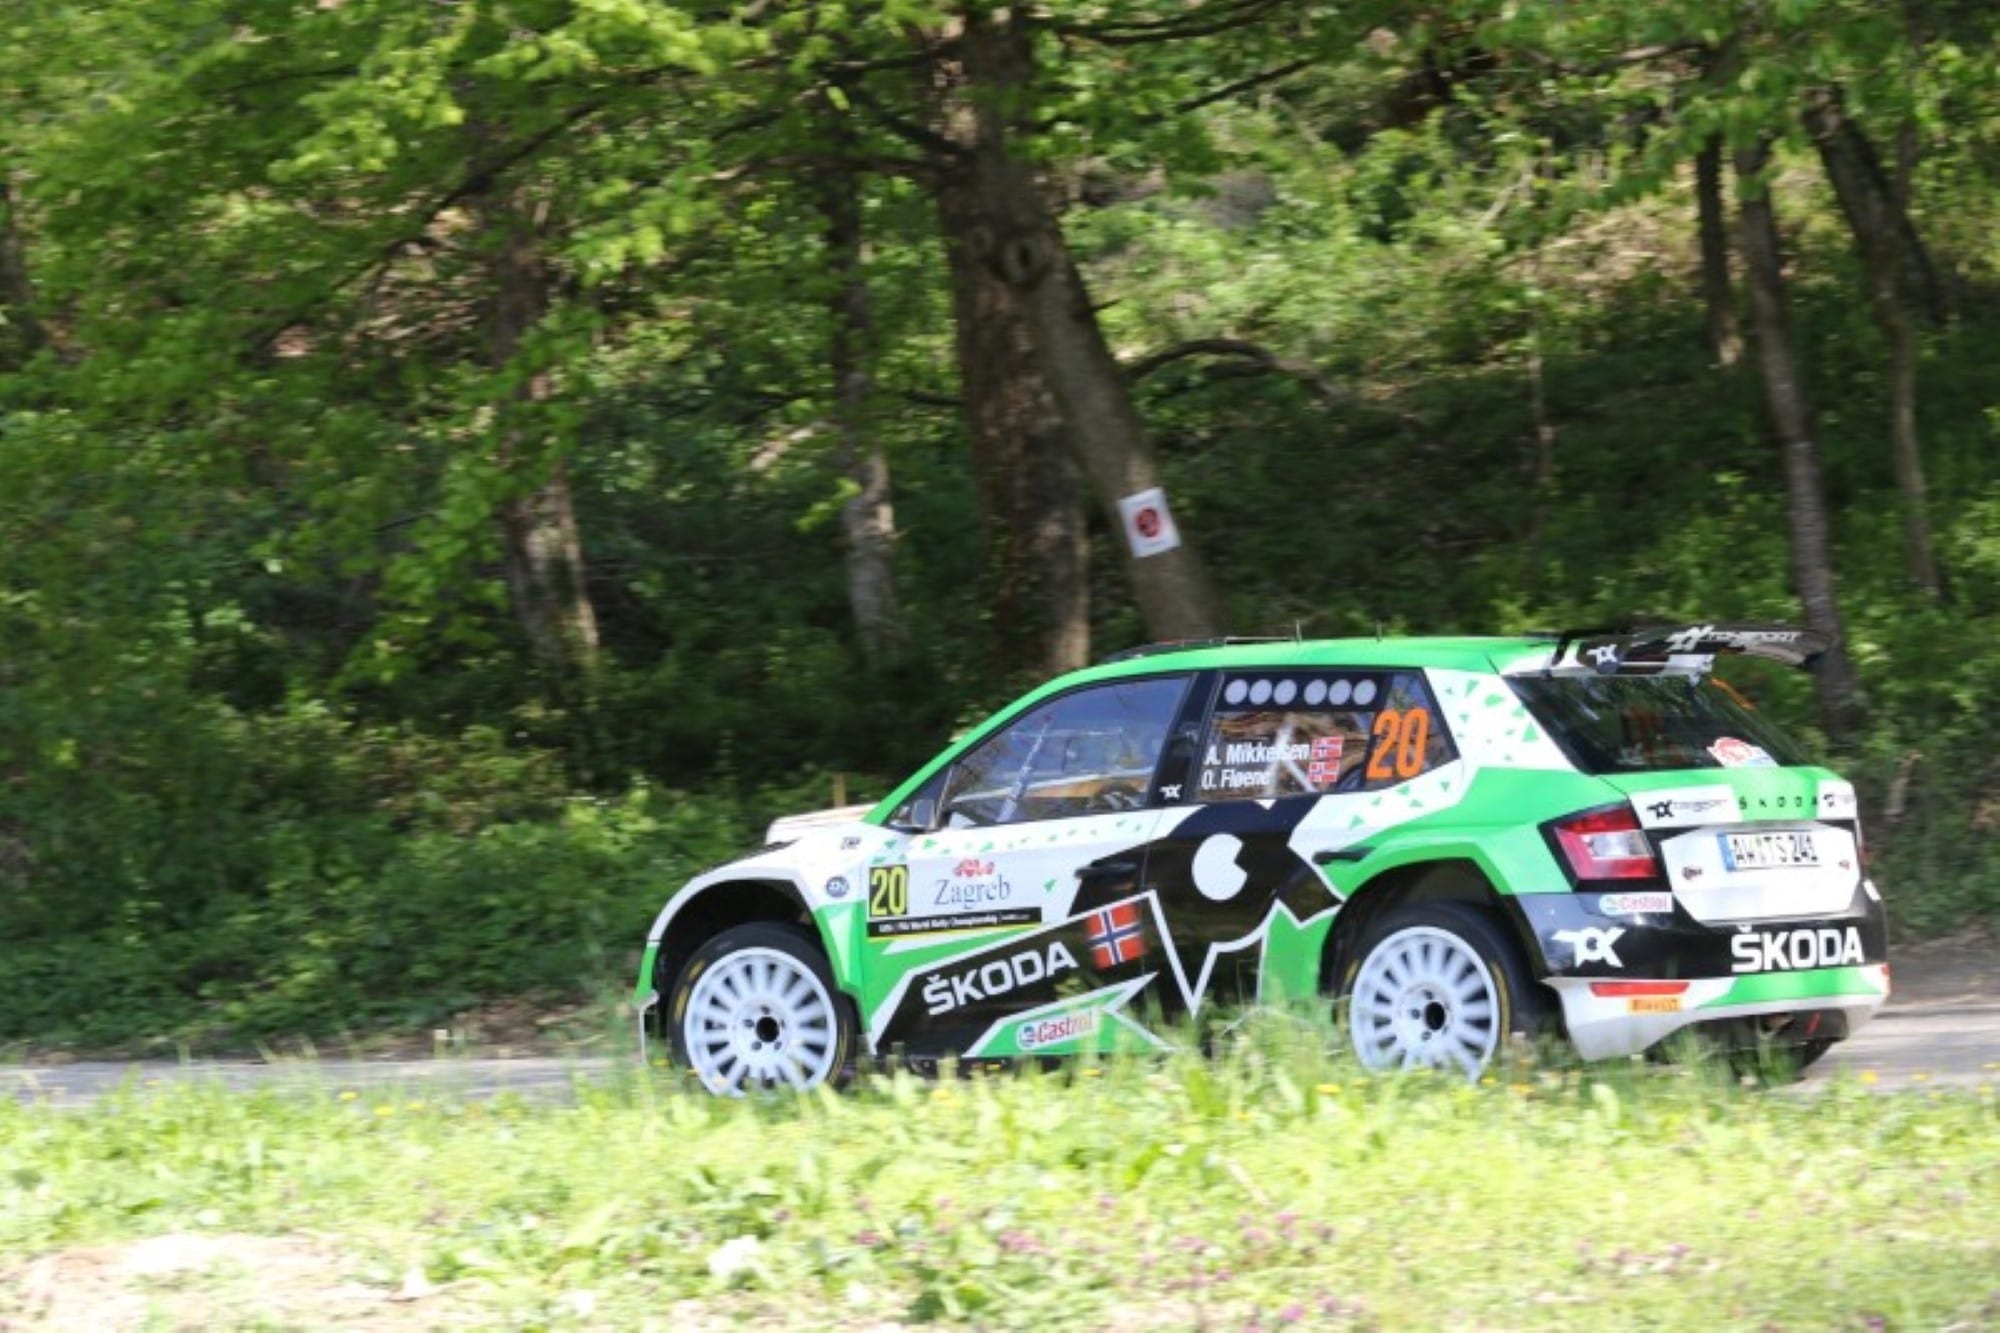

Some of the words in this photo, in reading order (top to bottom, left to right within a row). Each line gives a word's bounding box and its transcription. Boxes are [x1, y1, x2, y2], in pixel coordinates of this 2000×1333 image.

[1204, 743, 1221, 766] A.
[1366, 707, 1431, 781] 20
[871, 866, 908, 916] 20
[934, 873, 1011, 910] Zagreb
[1730, 923, 1865, 973] ŠKODA
[922, 941, 1079, 1016] ŠKODA
